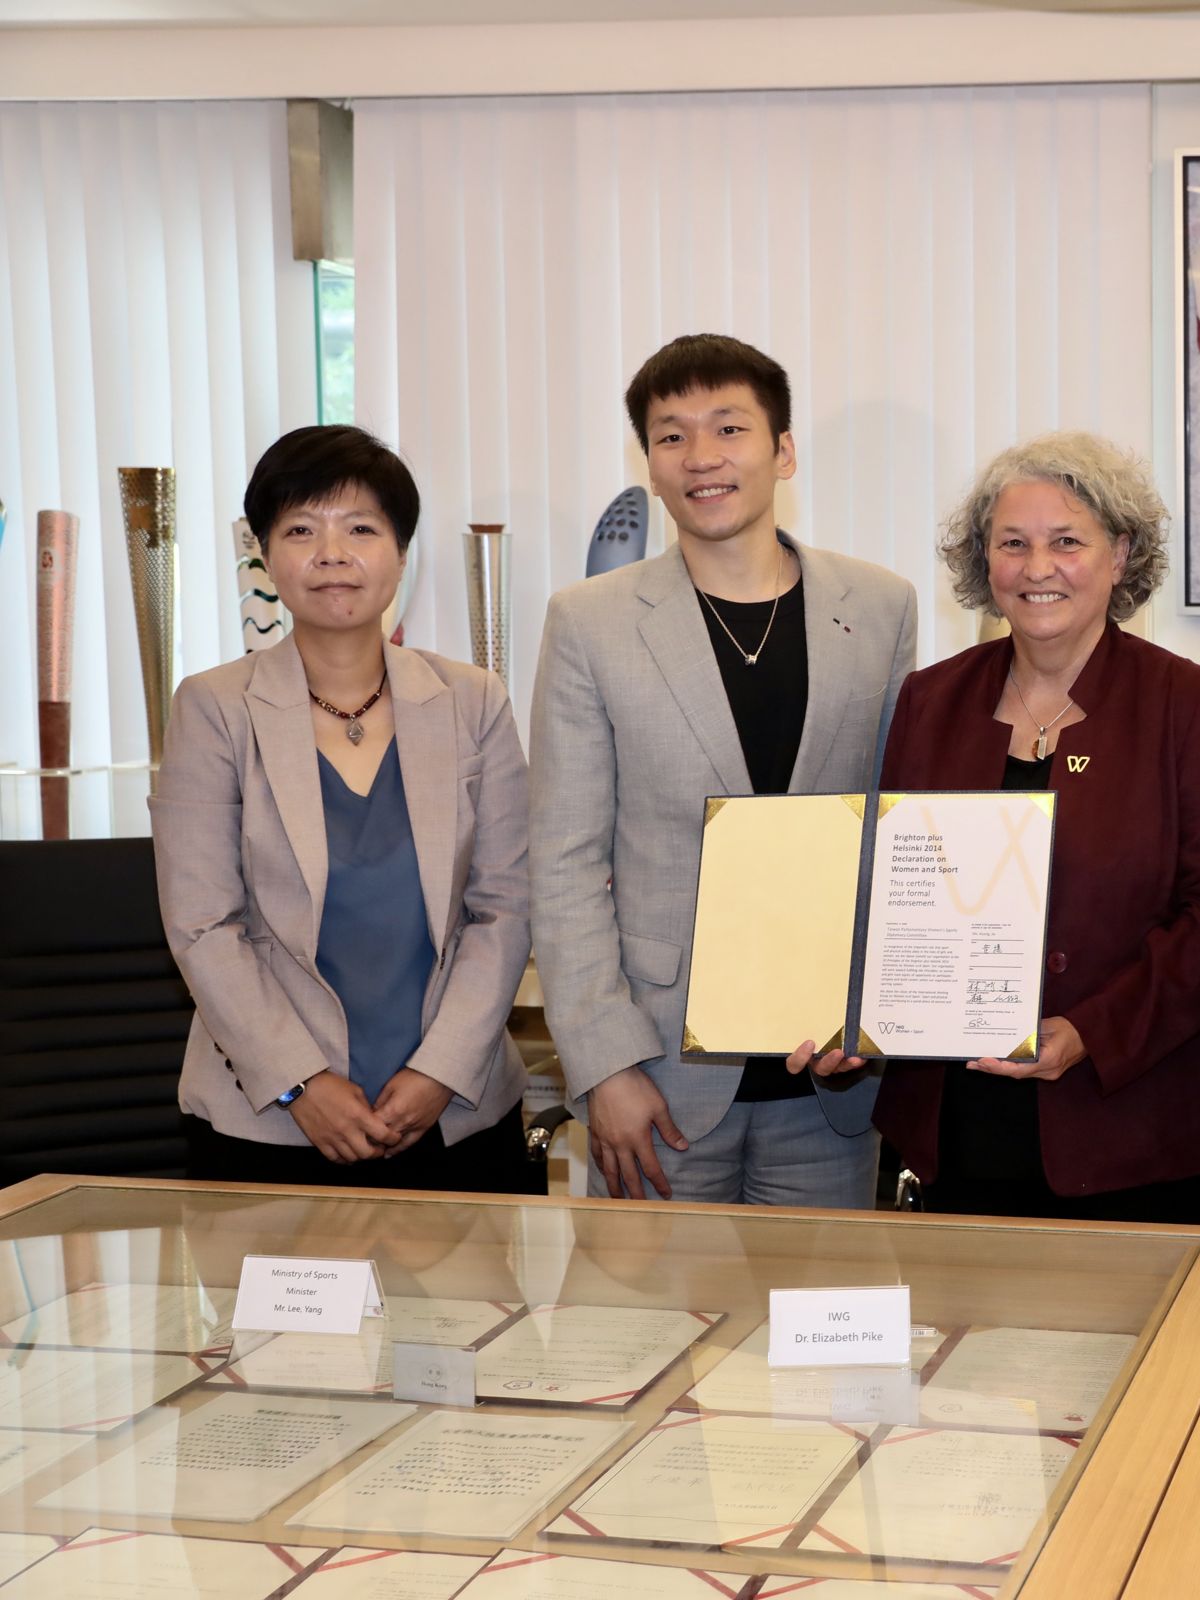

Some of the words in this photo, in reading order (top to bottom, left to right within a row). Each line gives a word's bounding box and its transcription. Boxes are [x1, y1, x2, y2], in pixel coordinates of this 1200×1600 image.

[894, 834, 925, 842] Brighton
[272, 1269, 302, 1279] Ministry
[313, 1271, 338, 1280] Sports
[286, 1288, 317, 1296] Minister
[304, 1306, 322, 1315] Yang
[828, 1312, 850, 1321] IWG
[795, 1334, 809, 1343] Dr.
[812, 1332, 859, 1343] Elizabeth
[862, 1332, 883, 1341] Pike
